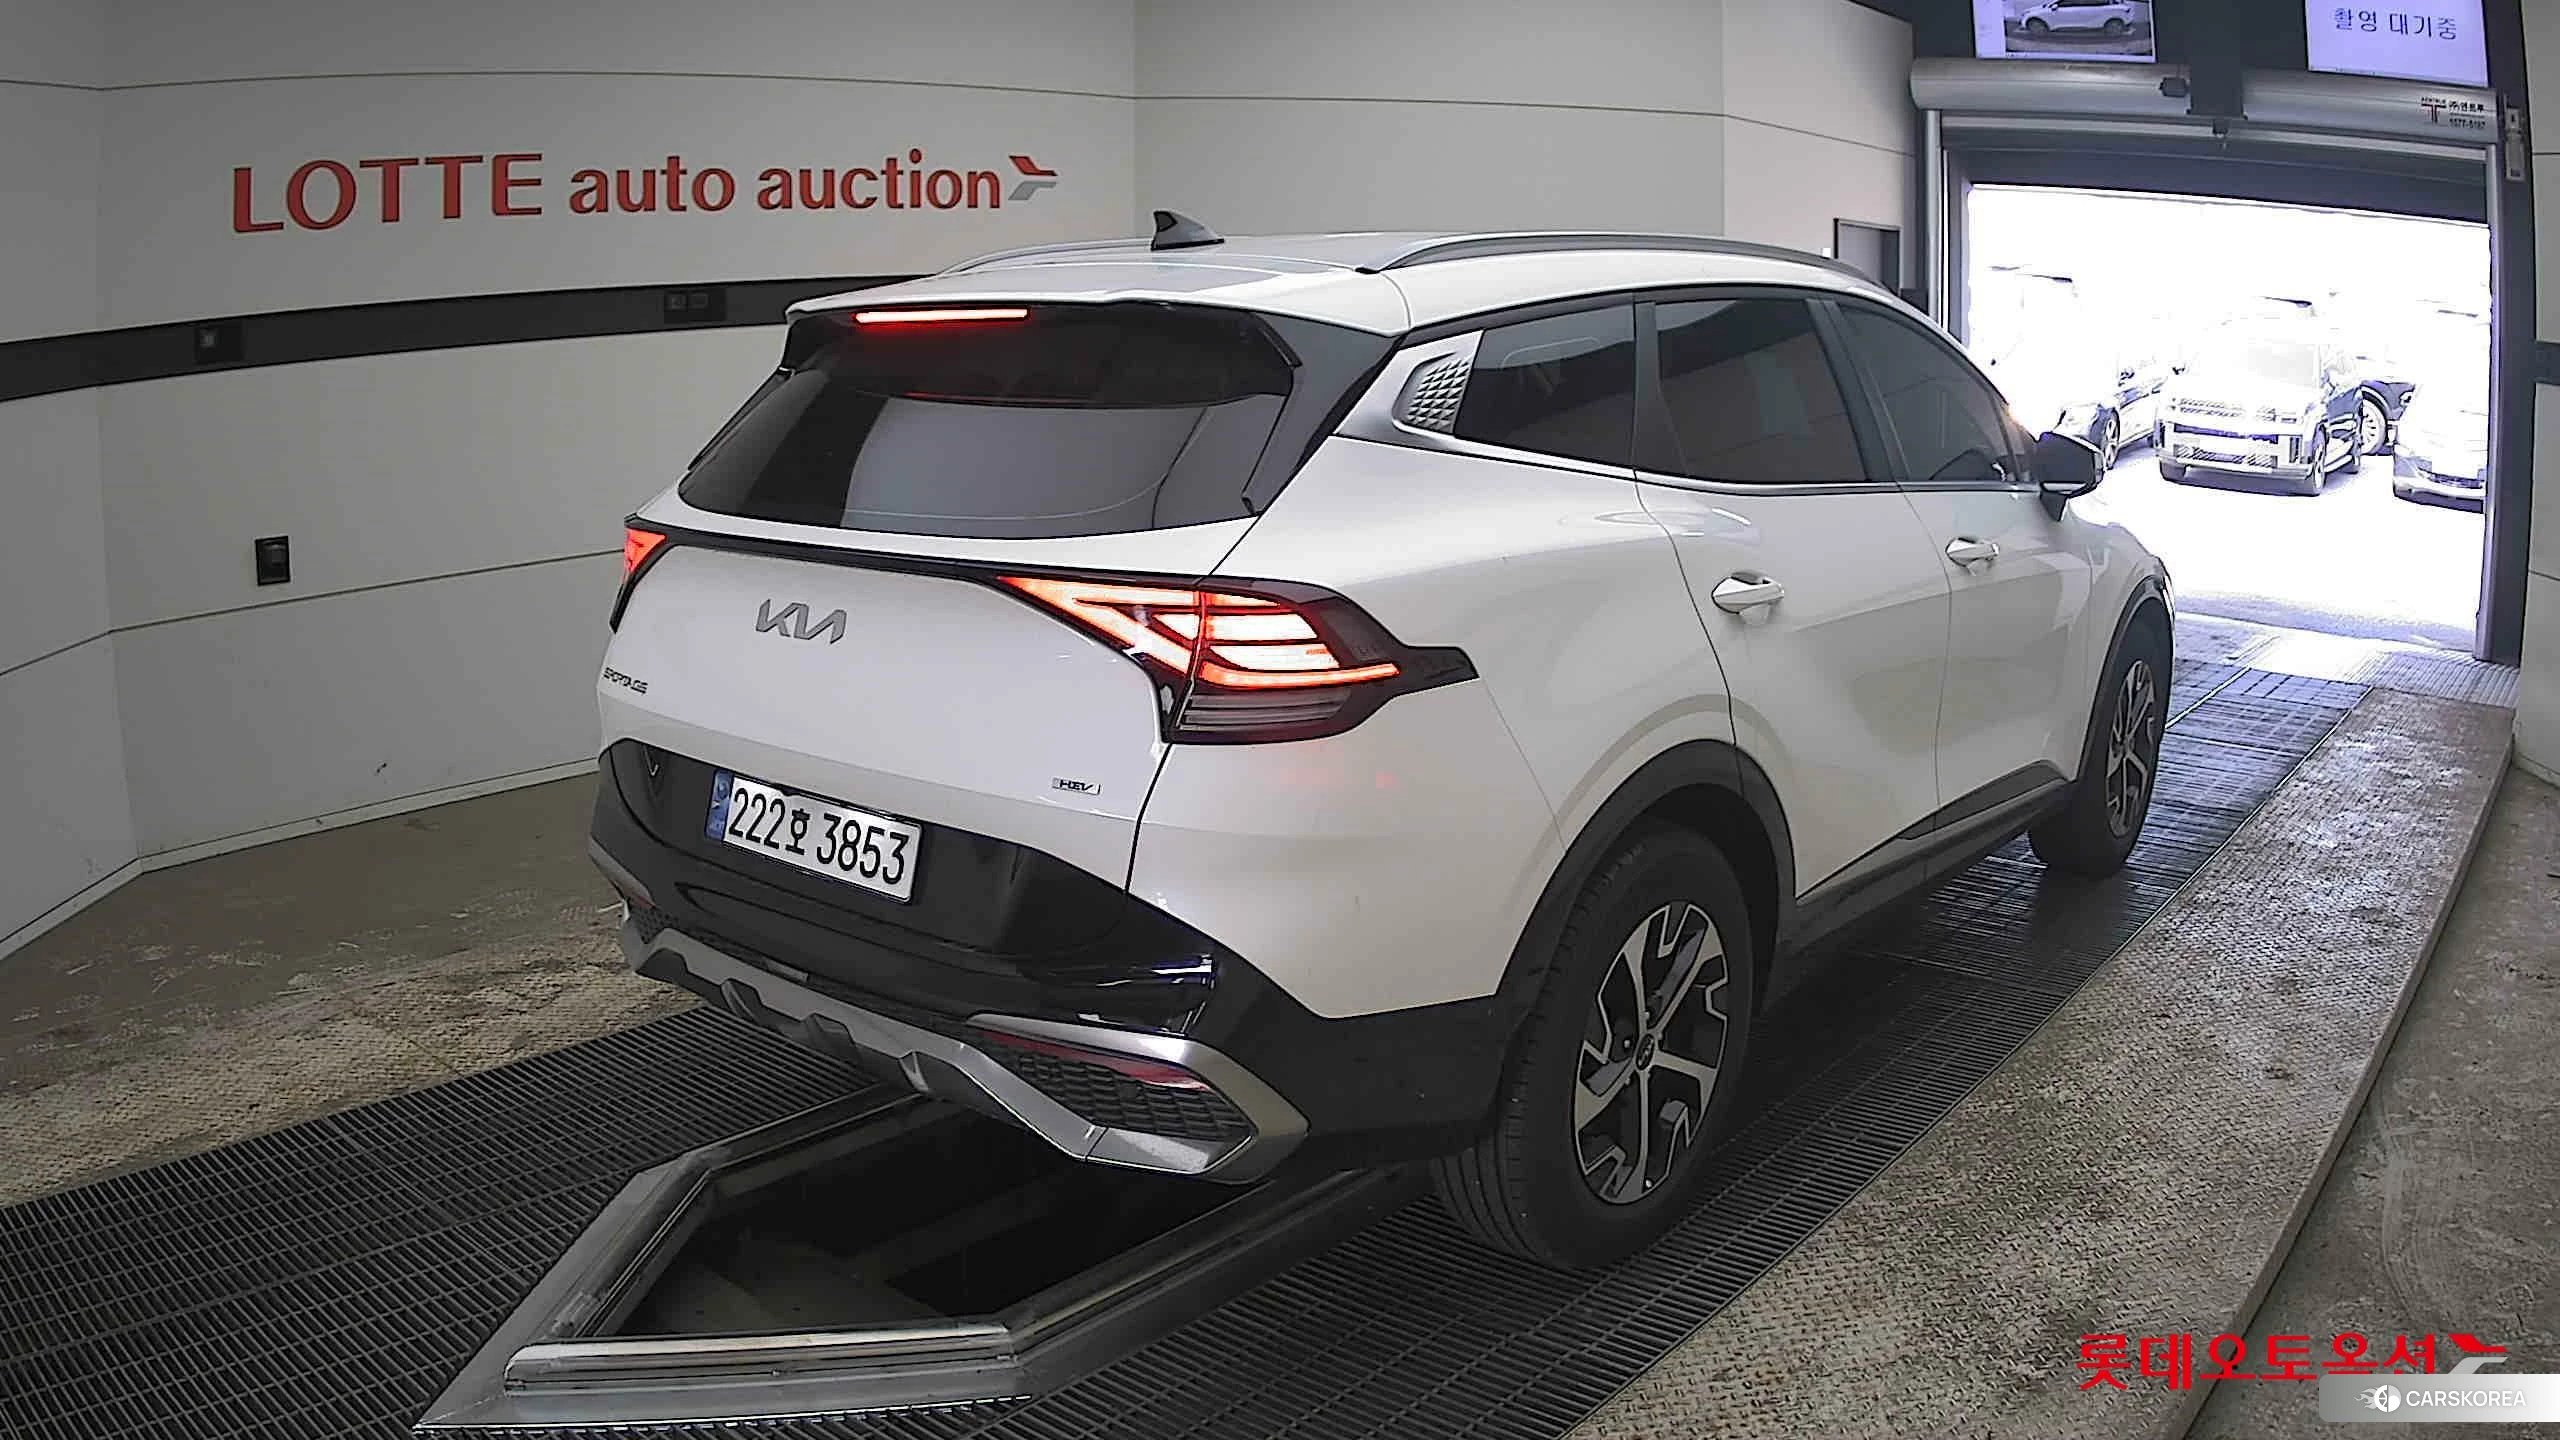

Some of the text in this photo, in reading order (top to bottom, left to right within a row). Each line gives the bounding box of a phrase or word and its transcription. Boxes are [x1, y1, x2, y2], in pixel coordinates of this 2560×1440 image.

[2334, 7, 2457, 40] 촬영 대기중
[233, 148, 1002, 233] LOTTE auto auction
[728, 787, 910, 885] 222호 3853
